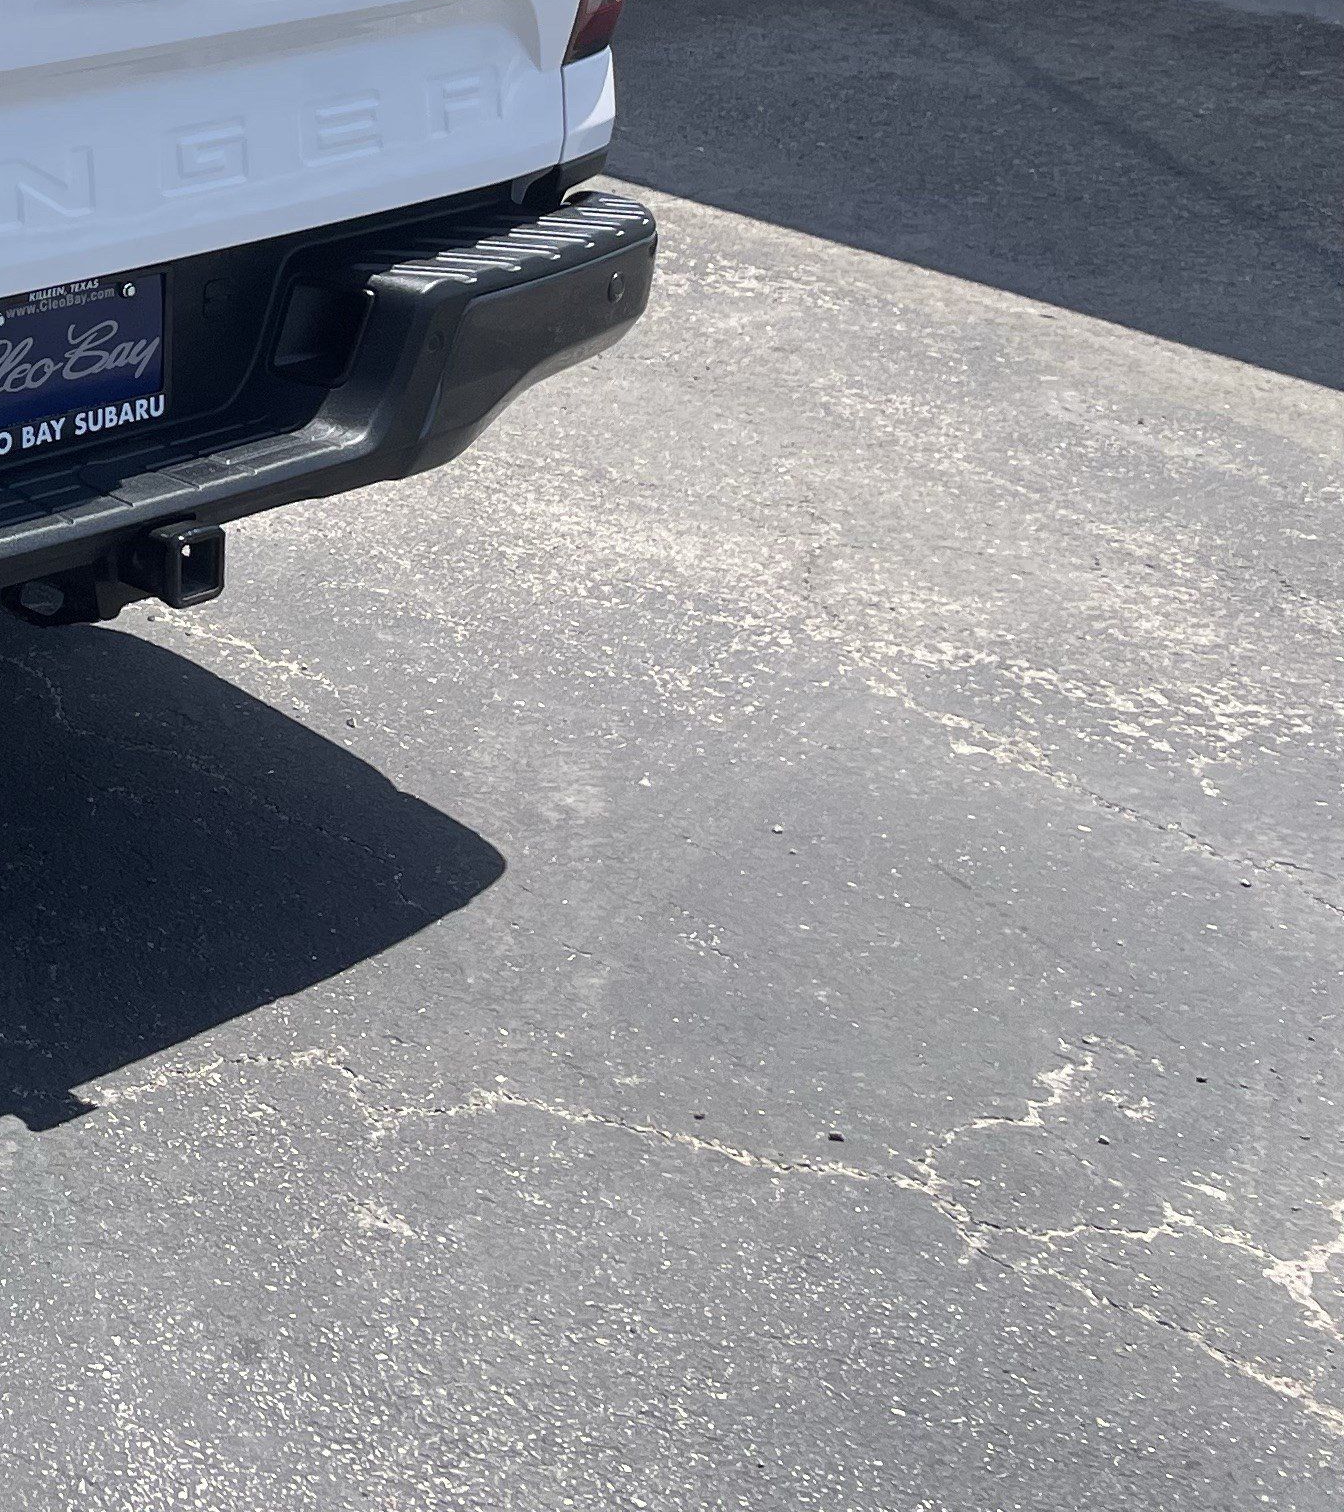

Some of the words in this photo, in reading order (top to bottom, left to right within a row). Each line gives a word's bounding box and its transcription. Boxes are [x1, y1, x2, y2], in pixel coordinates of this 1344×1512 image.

[5, 288, 115, 319] www.CleoBay.com
[70, 279, 99, 293] TEXAS
[62, 320, 160, 379] Bay
[21, 417, 66, 449] BAY
[74, 394, 165, 436] SUBARU
